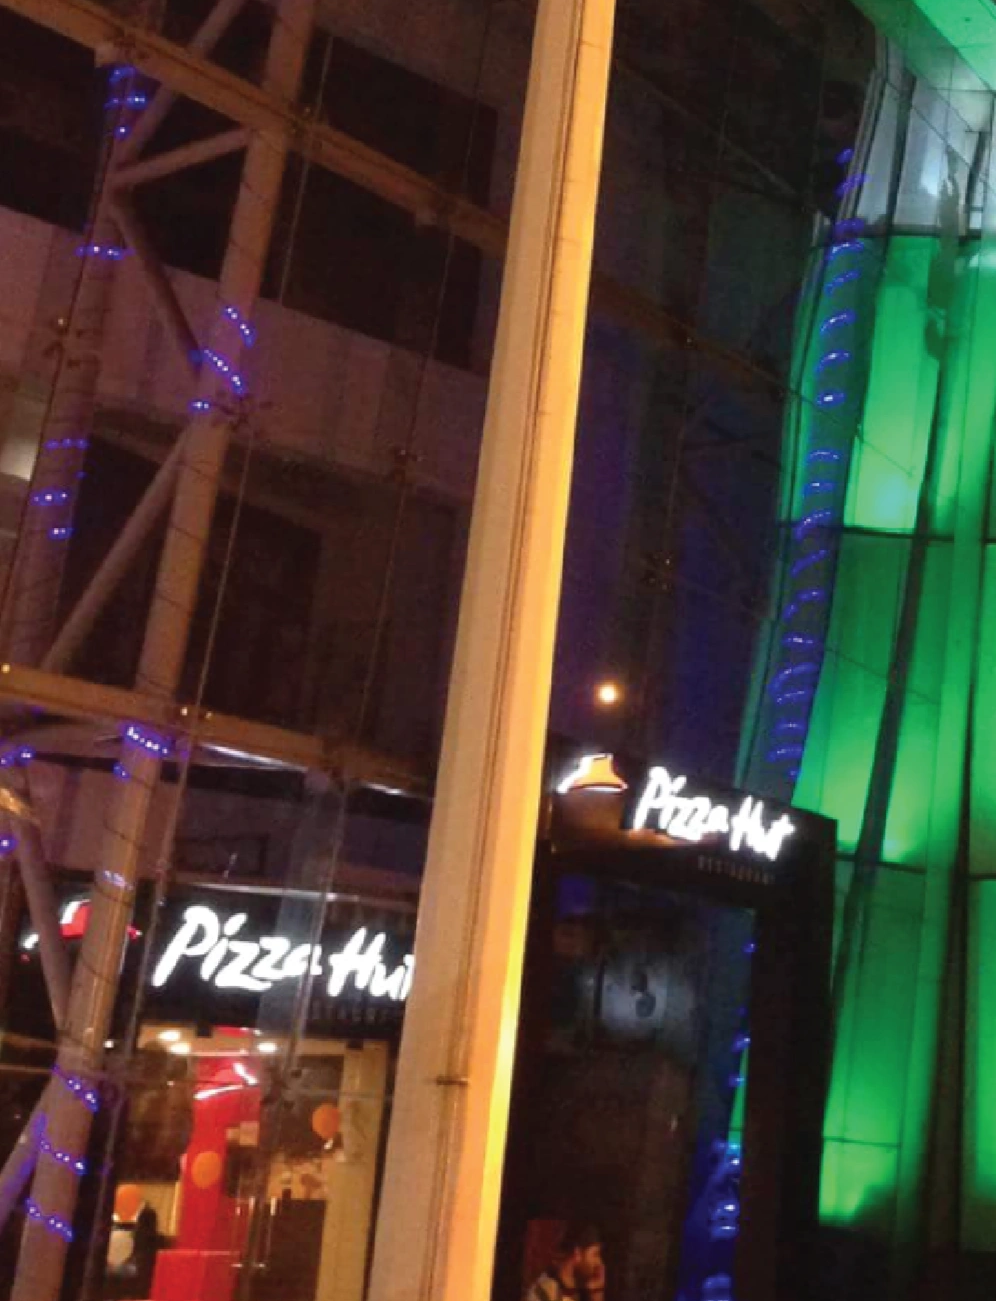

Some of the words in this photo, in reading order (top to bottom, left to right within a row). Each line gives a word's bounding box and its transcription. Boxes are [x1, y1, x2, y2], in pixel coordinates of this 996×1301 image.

[633, 765, 729, 841] Pizza
[729, 794, 795, 862] Hut
[152, 905, 322, 991] Pizza
